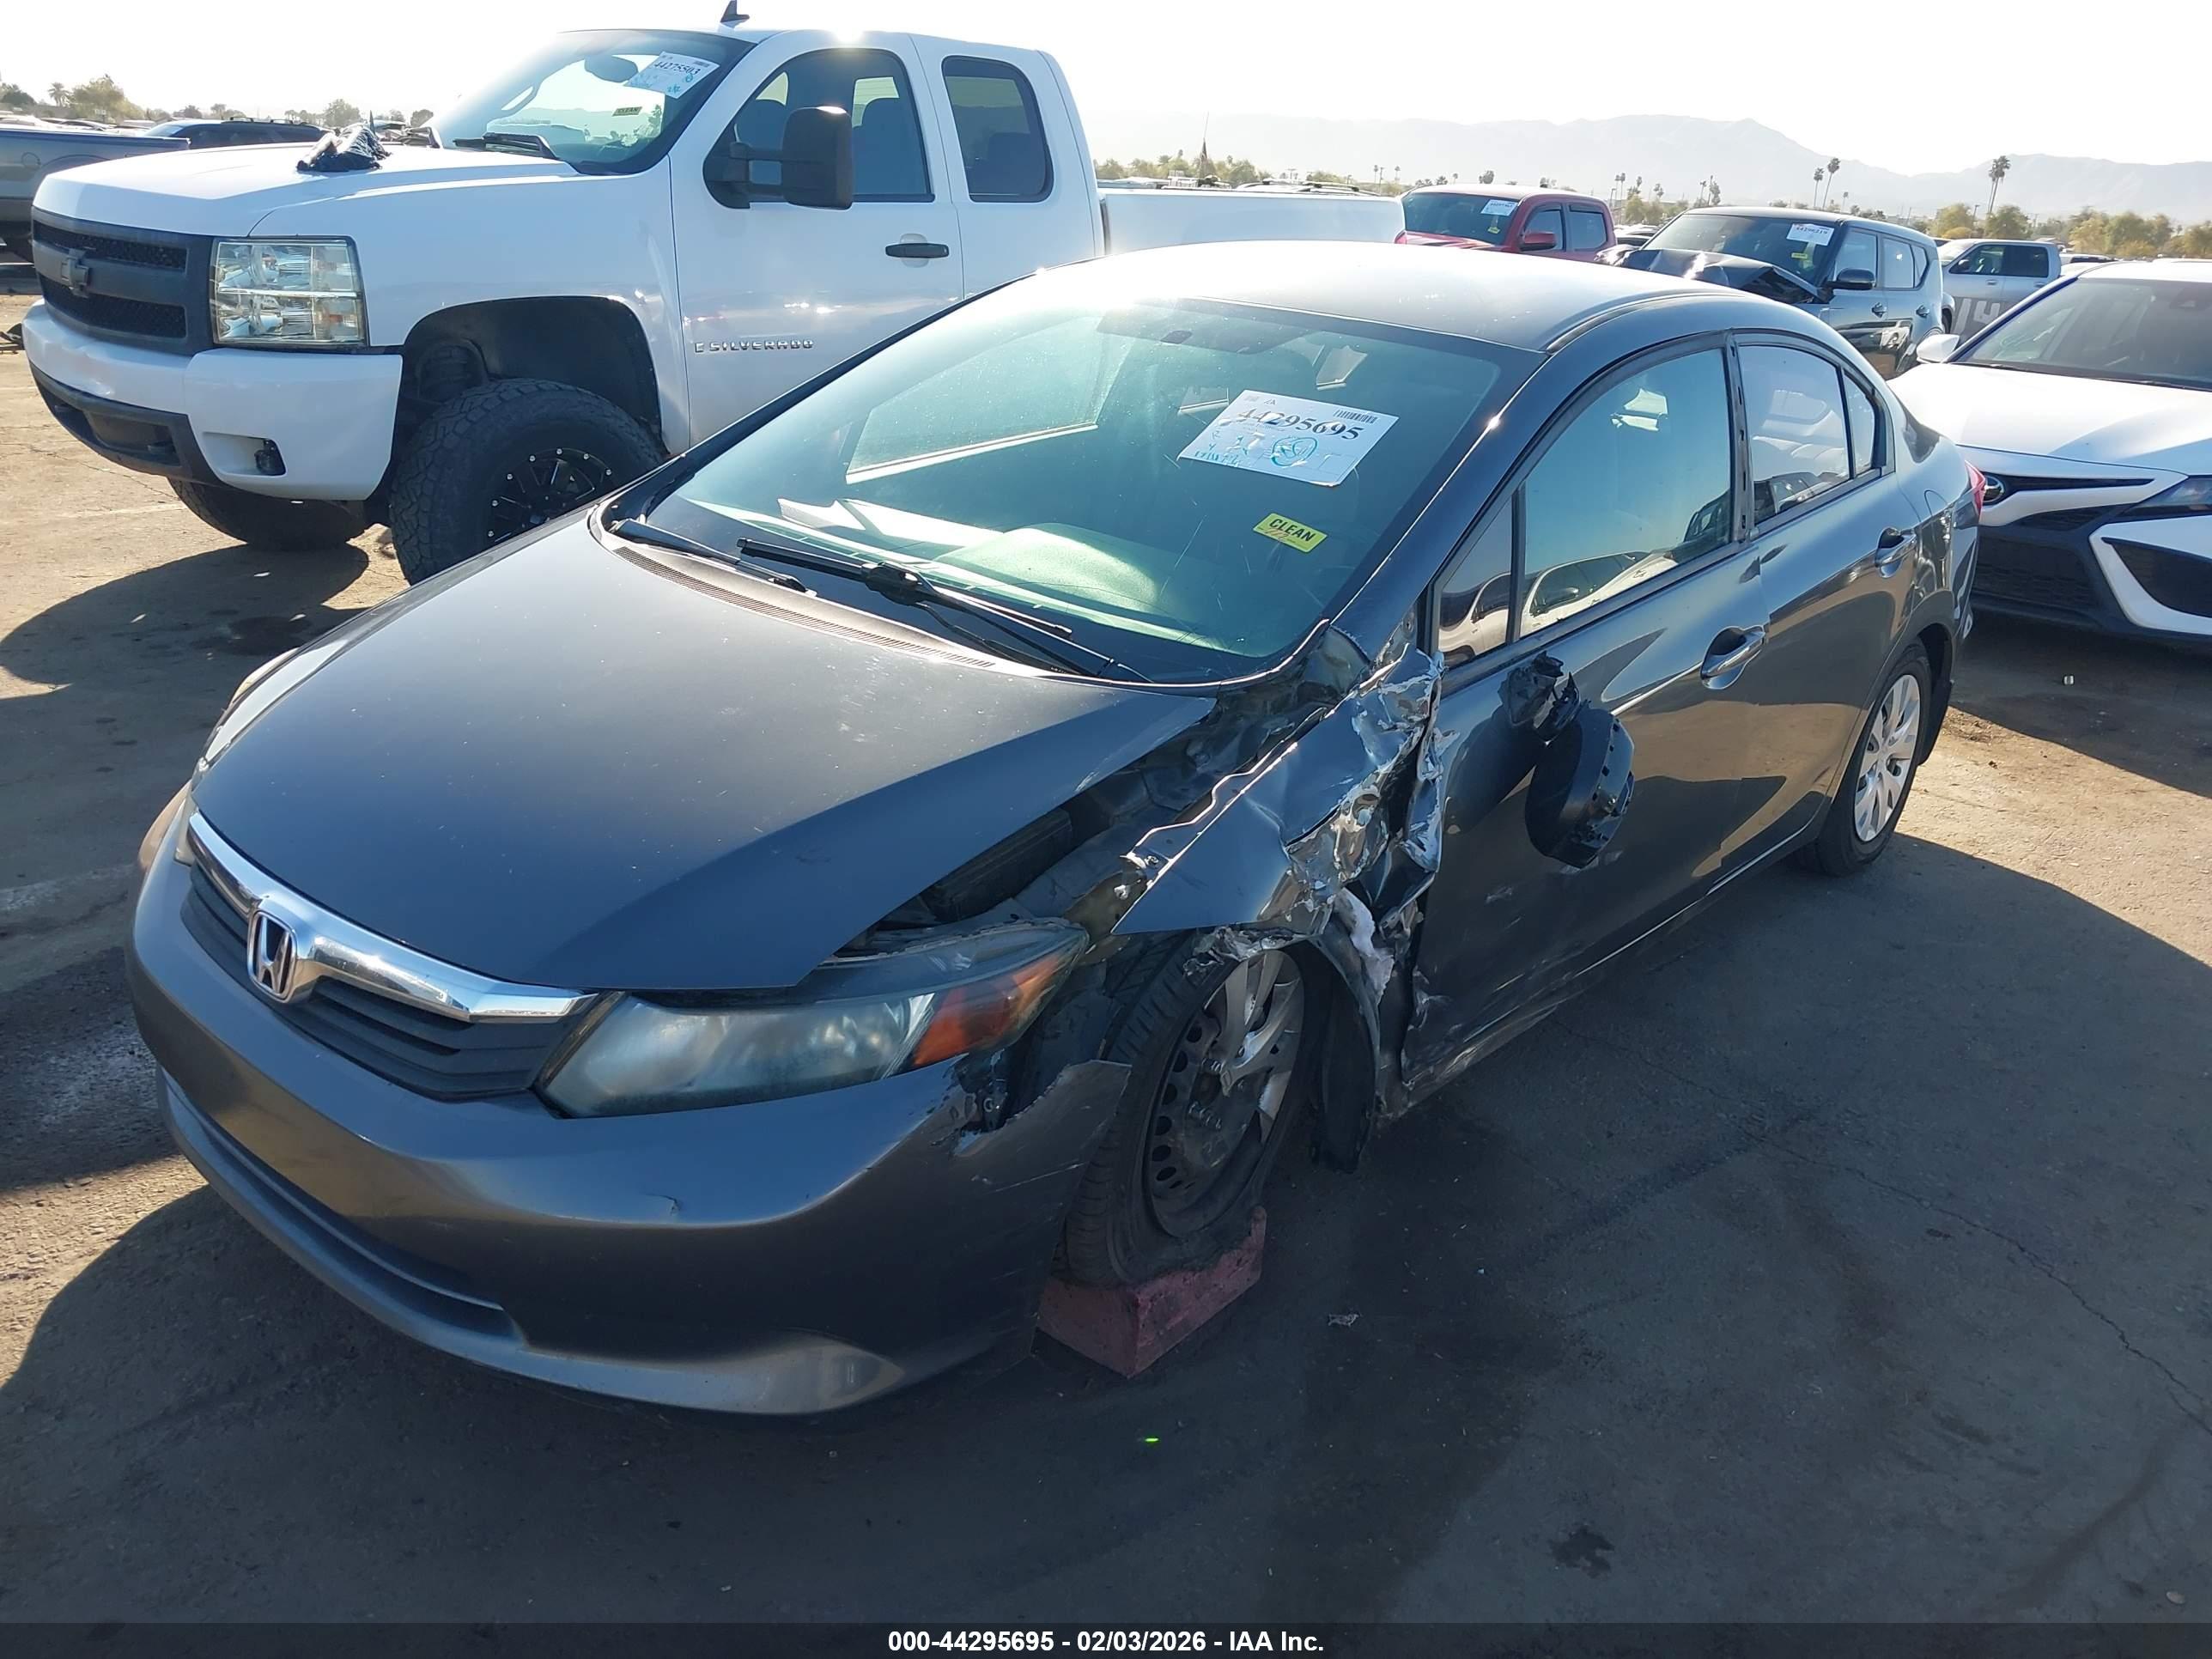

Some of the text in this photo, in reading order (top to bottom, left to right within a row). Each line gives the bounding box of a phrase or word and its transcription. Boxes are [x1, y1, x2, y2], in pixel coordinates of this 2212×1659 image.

[709, 339, 814, 352] SILVERADO
[1238, 407, 1365, 441] 44295695
[1269, 518, 1316, 542] CLEAN
